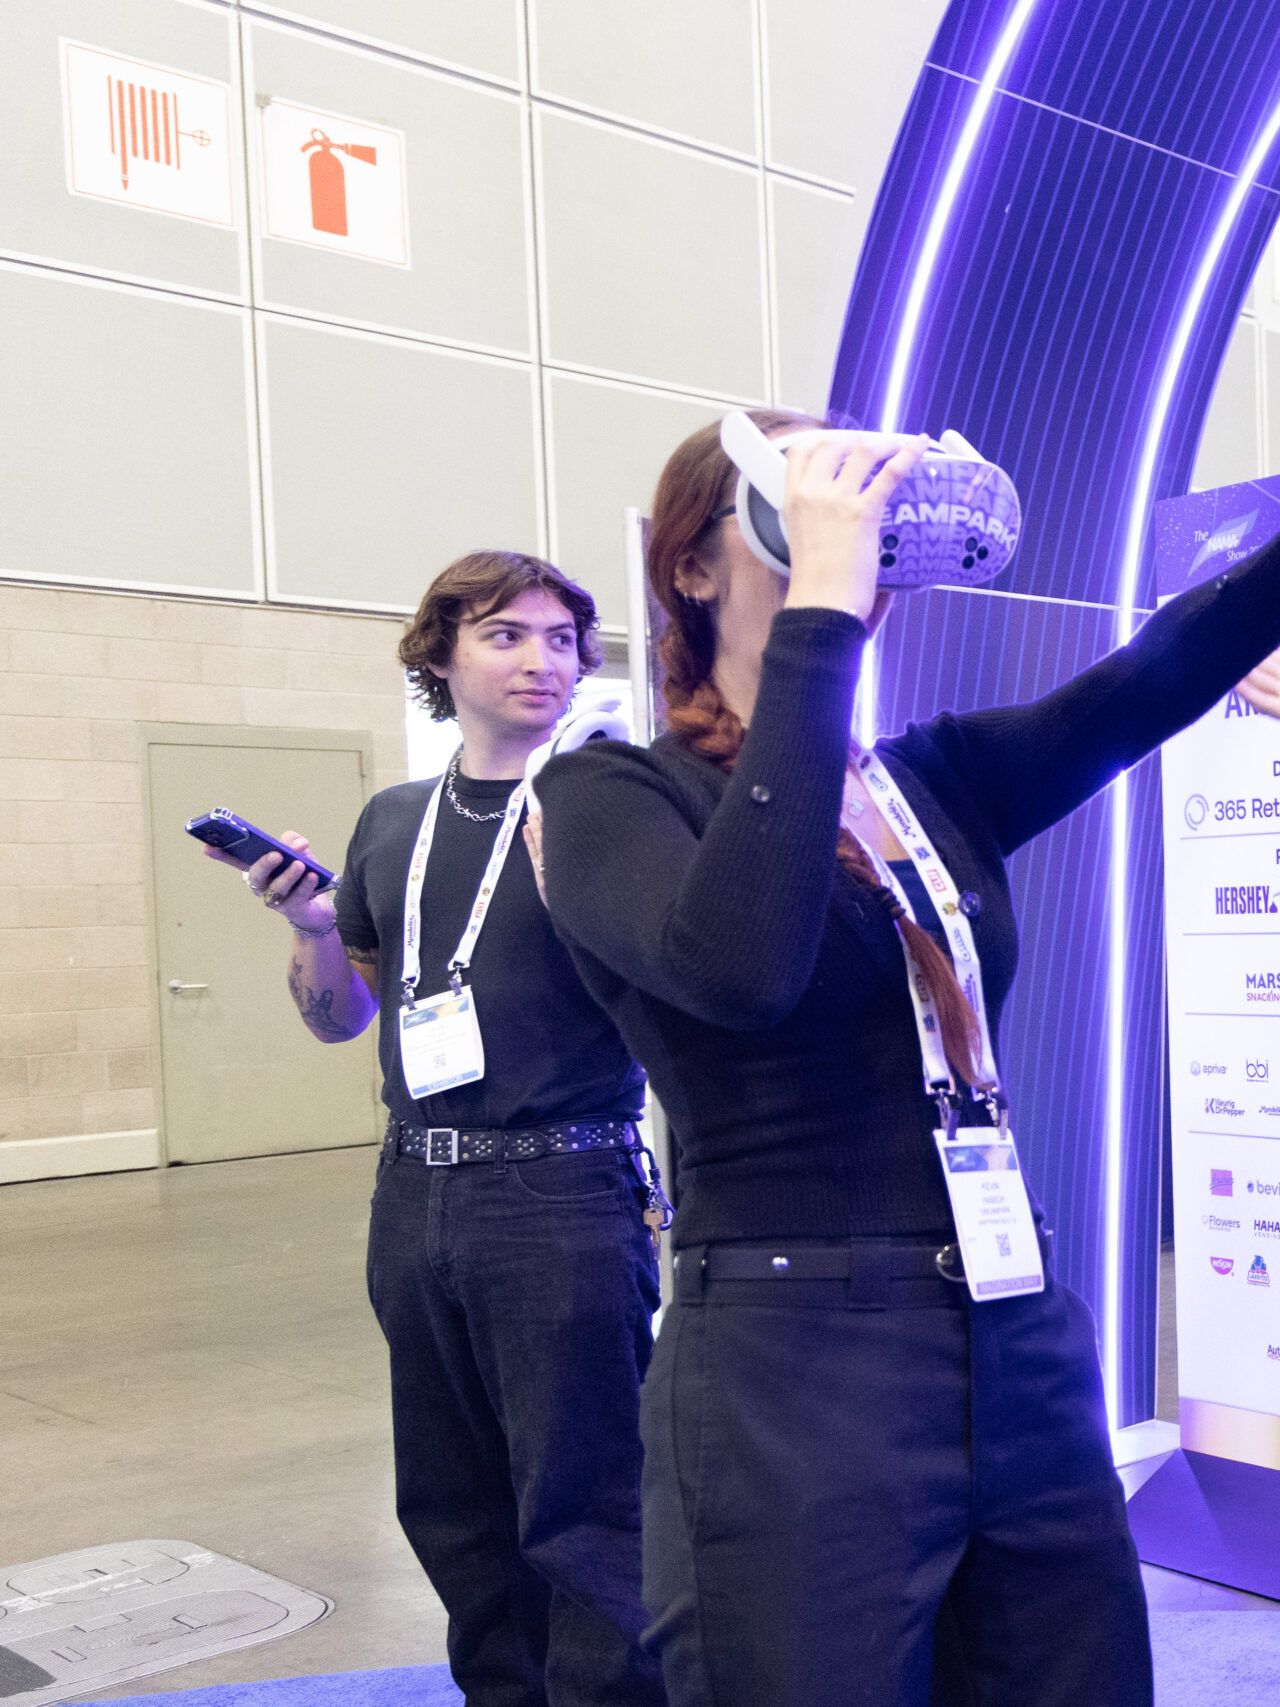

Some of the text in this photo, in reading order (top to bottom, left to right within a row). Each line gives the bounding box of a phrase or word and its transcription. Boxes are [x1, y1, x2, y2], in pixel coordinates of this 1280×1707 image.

[1193, 530, 1209, 542] The
[1226, 548, 1247, 562] Show
[1215, 800, 1247, 821] 365
[1215, 885, 1270, 914] HERSHEY
[1257, 1180, 1280, 1196] bevi
[1209, 1215, 1240, 1229] Flowers
[1254, 1219, 1280, 1233] HAHA
